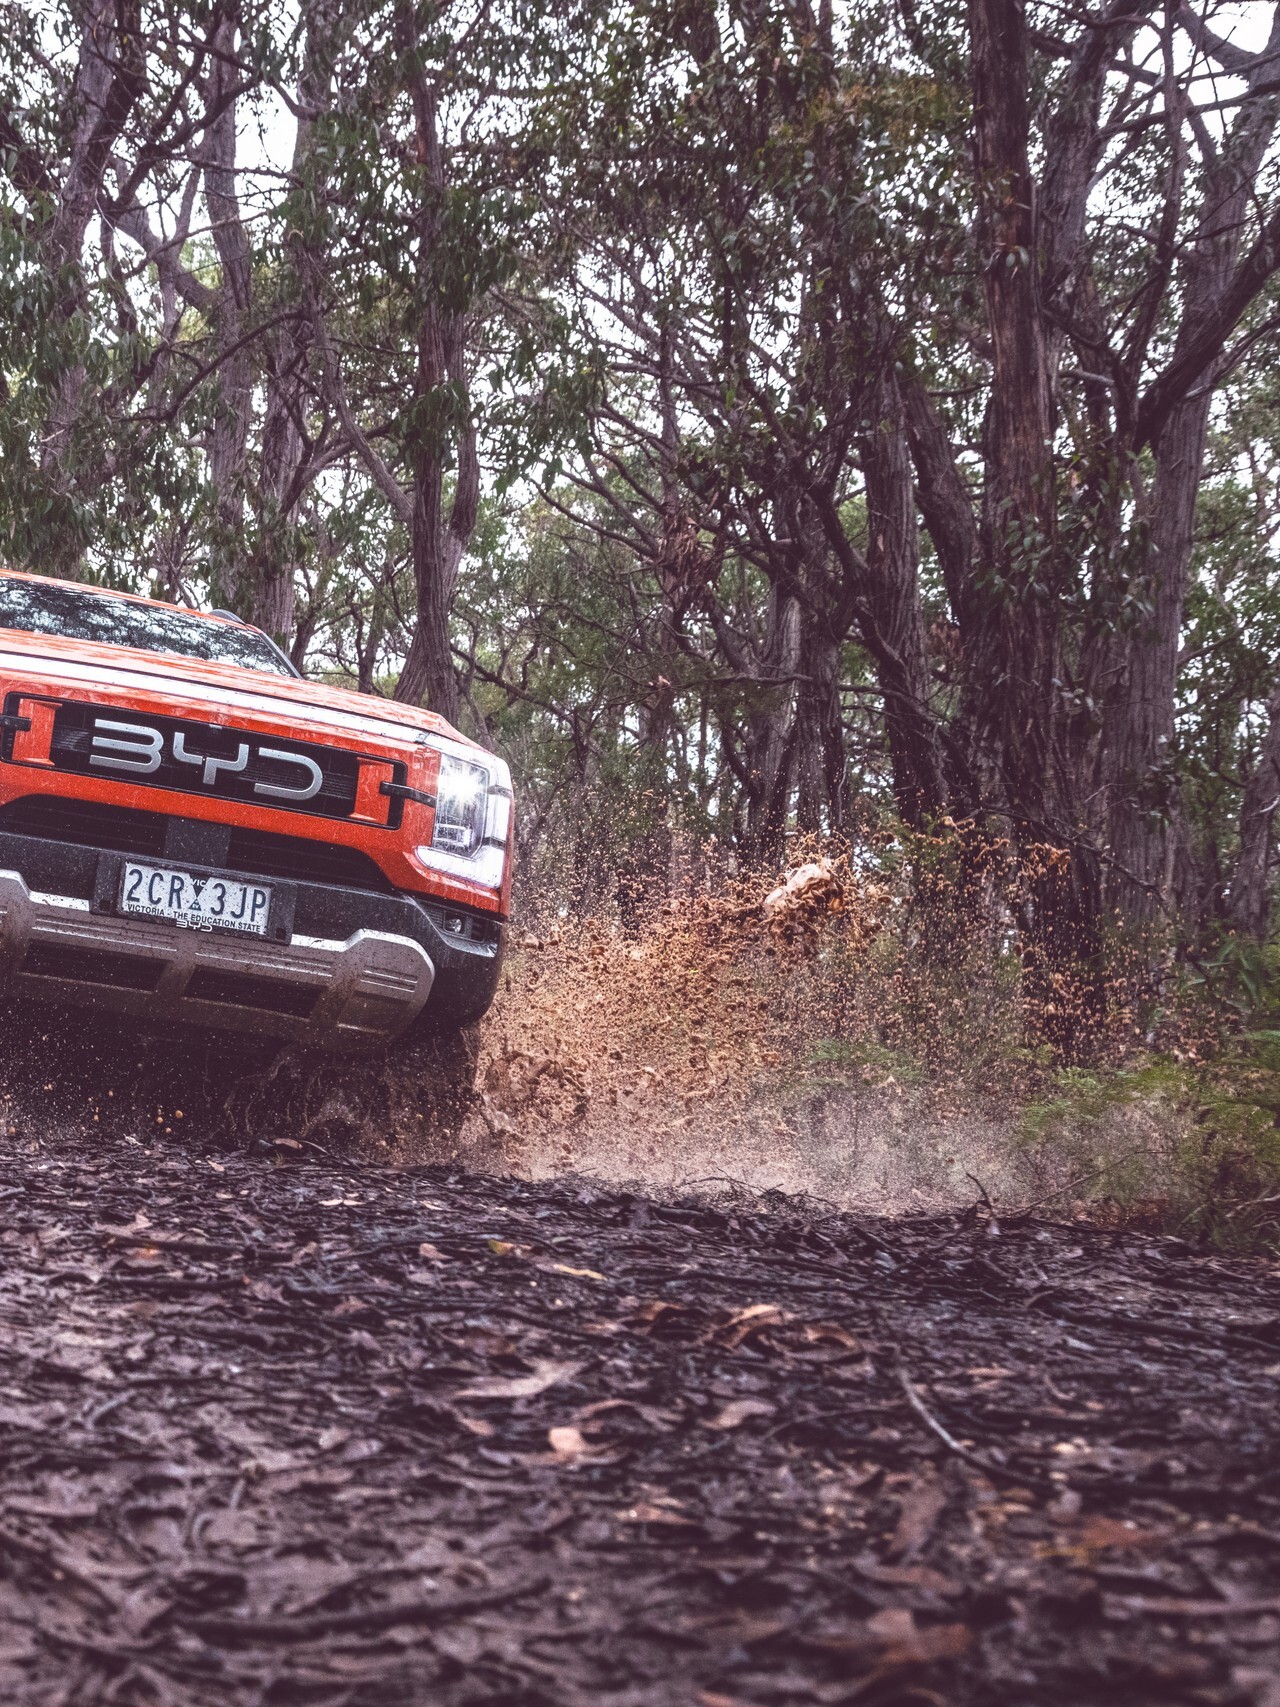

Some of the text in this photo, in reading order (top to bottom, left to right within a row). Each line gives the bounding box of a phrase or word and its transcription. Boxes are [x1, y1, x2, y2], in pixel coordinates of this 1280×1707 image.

[89, 718, 323, 800] BYD
[126, 868, 267, 922] 2CR 3JP
[191, 878, 207, 888] VIC
[127, 903, 165, 916] VICTORIA
[173, 910, 188, 920] THE
[190, 913, 236, 928] EDUCATION
[238, 922, 261, 933] STATE
[176, 919, 213, 932] BYD
